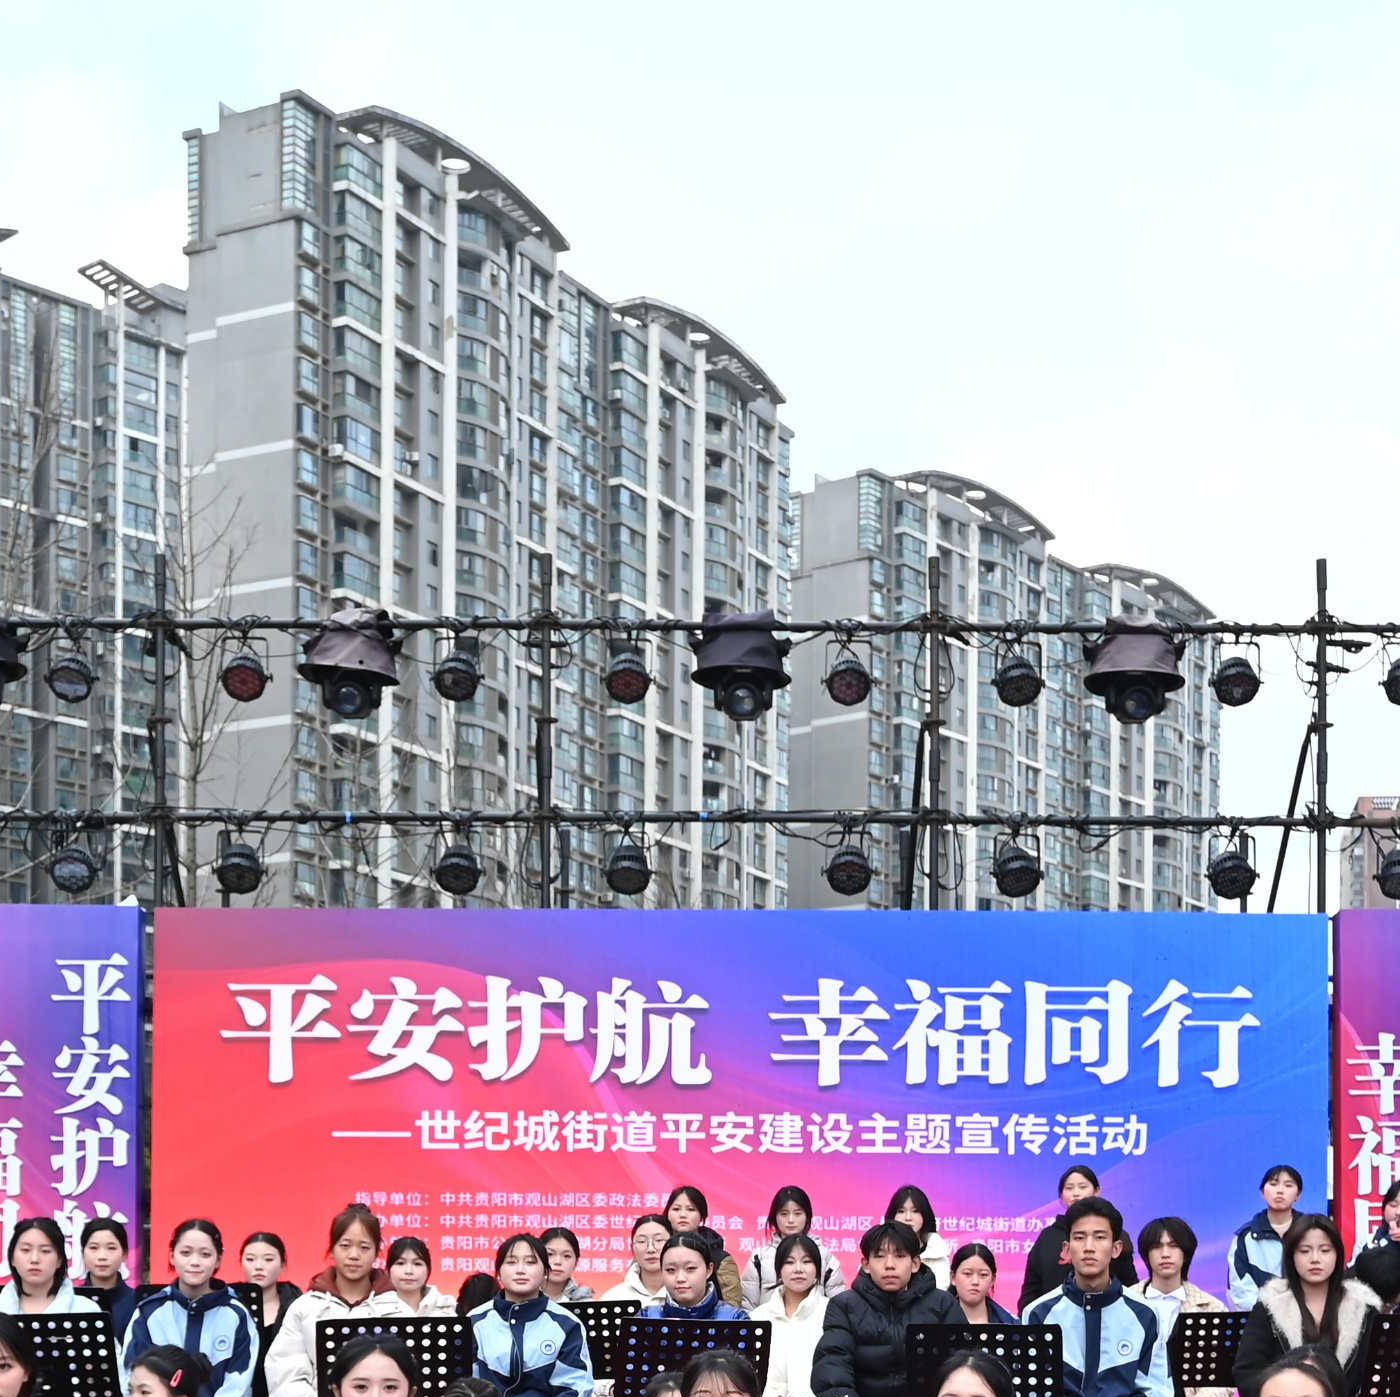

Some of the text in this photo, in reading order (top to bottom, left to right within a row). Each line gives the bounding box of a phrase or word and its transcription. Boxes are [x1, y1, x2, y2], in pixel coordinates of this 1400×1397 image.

[219, 974, 1261, 1089] 平安护航 幸福同行
